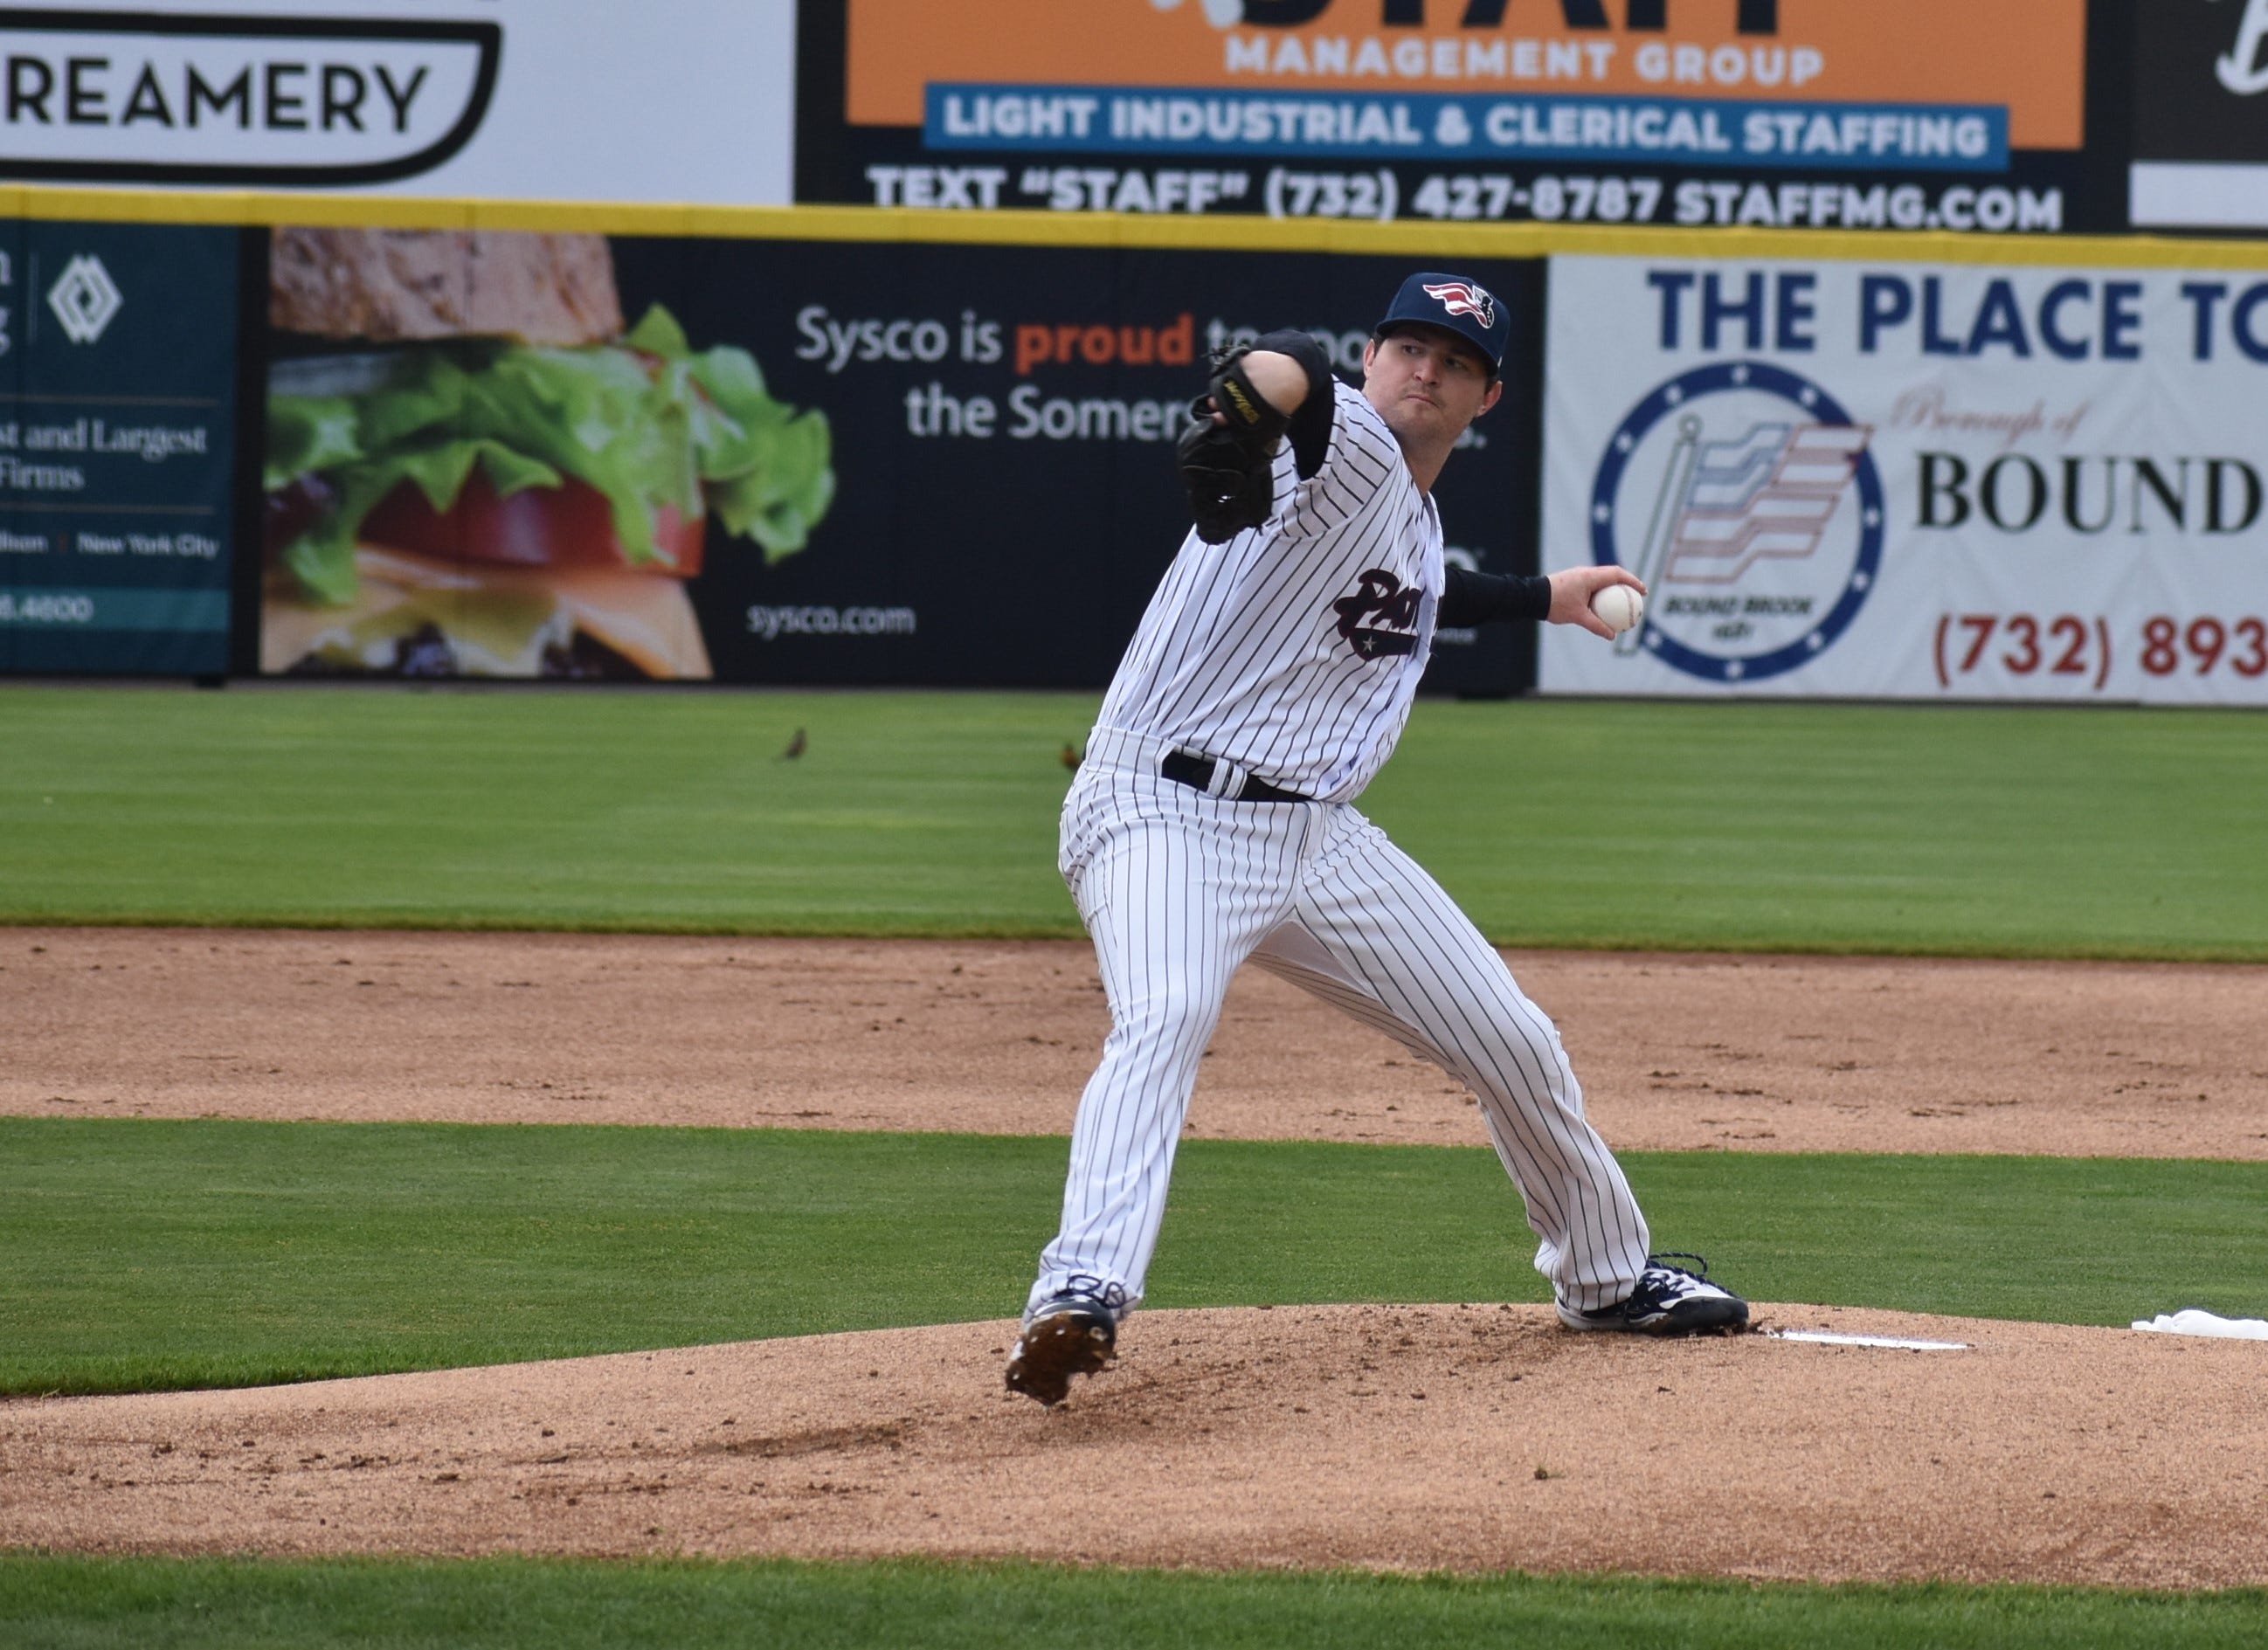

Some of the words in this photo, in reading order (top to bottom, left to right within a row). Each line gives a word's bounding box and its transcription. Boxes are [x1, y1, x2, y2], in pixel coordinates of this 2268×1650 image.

[1224, 35, 1616, 79] MANAGEMENT
[1634, 42, 1823, 86] GROUP
[4, 55, 431, 134] REAMERY
[944, 95, 1098, 138] LIGHT
[1111, 98, 1421, 146] INDUSTRIAL
[1435, 104, 1472, 147] &
[1485, 105, 1732, 154] CLERICAL
[1743, 112, 1990, 159] STAFFING
[868, 165, 1008, 209] TEXT
[1021, 168, 1249, 215] “STAFF”
[1263, 169, 1397, 223] (732)
[1413, 176, 1663, 223] 427-8787
[1674, 181, 2064, 231] STAFFMG.COM
[795, 304, 951, 374] Sysco
[958, 308, 1004, 365] is
[1014, 311, 1194, 376] proud
[1647, 269, 1818, 353] THE
[1858, 273, 2143, 361] PLACE
[903, 379, 999, 438] the
[24, 418, 87, 452] and
[92, 418, 209, 464] Largest
[1915, 451, 2263, 535] BOUND
[76, 531, 126, 556] New
[128, 532, 173, 556] York
[176, 533, 220, 561] City
[746, 604, 916, 641] sysco.com
[1663, 595, 1738, 616] BOUND
[1743, 595, 1815, 616] BROOK
[1934, 612, 2112, 692] (732)
[2140, 614, 2268, 680] 893
